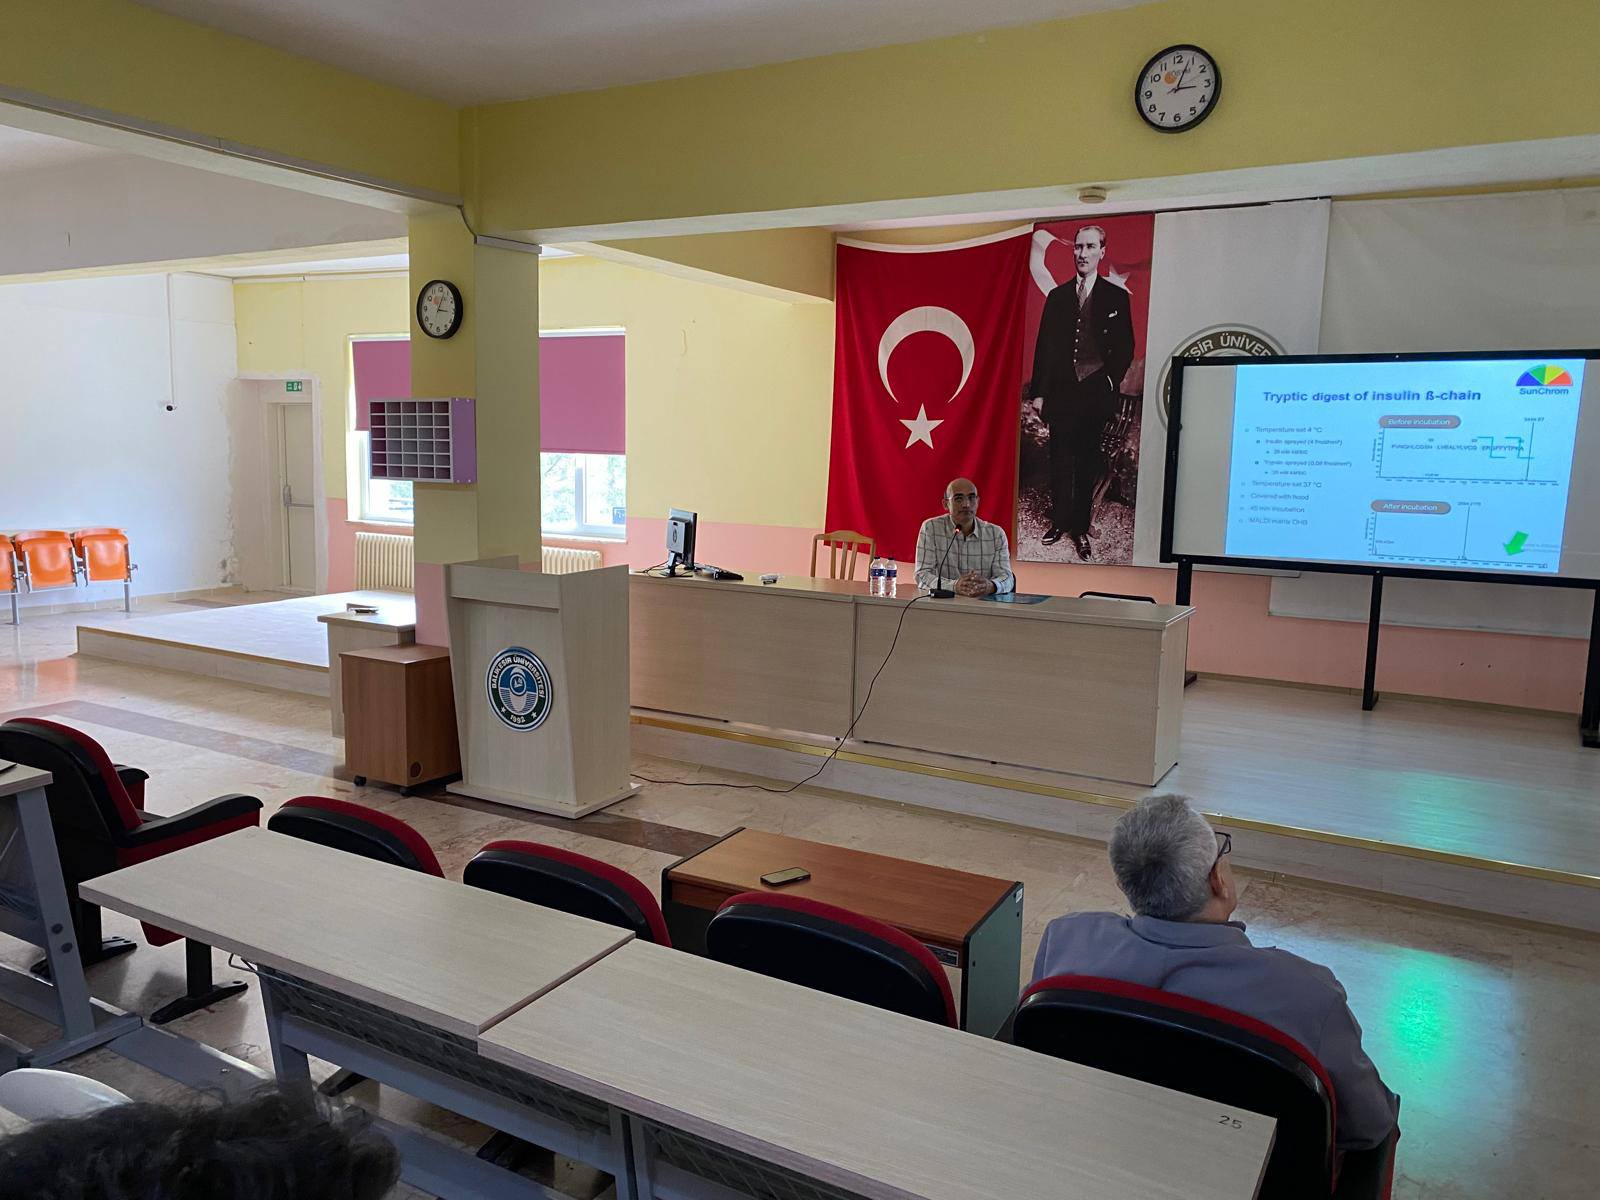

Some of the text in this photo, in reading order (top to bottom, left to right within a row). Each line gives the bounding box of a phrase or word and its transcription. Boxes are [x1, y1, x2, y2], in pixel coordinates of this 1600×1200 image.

[1174, 54, 1184, 64] 12
[1192, 56, 1194, 65] 1
[1160, 62, 1167, 71] 11
[1199, 64, 1206, 73] 2
[1150, 74, 1161, 83] 10
[1204, 79, 1211, 88] 3
[1145, 90, 1152, 99] 9
[1199, 95, 1206, 103] 4
[1149, 104, 1156, 112] 8
[1190, 106, 1196, 115] 5
[1158, 112, 1166, 122] 7
[1173, 113, 1181, 122] 6
[1263, 392, 1308, 403] Tryptic
[1312, 392, 1350, 402] digest
[1354, 391, 1369, 400] of
[1372, 390, 1420, 400] insulin
[492, 656, 512, 688] BALIKESİR
[1218, 1115, 1242, 1129] 25
